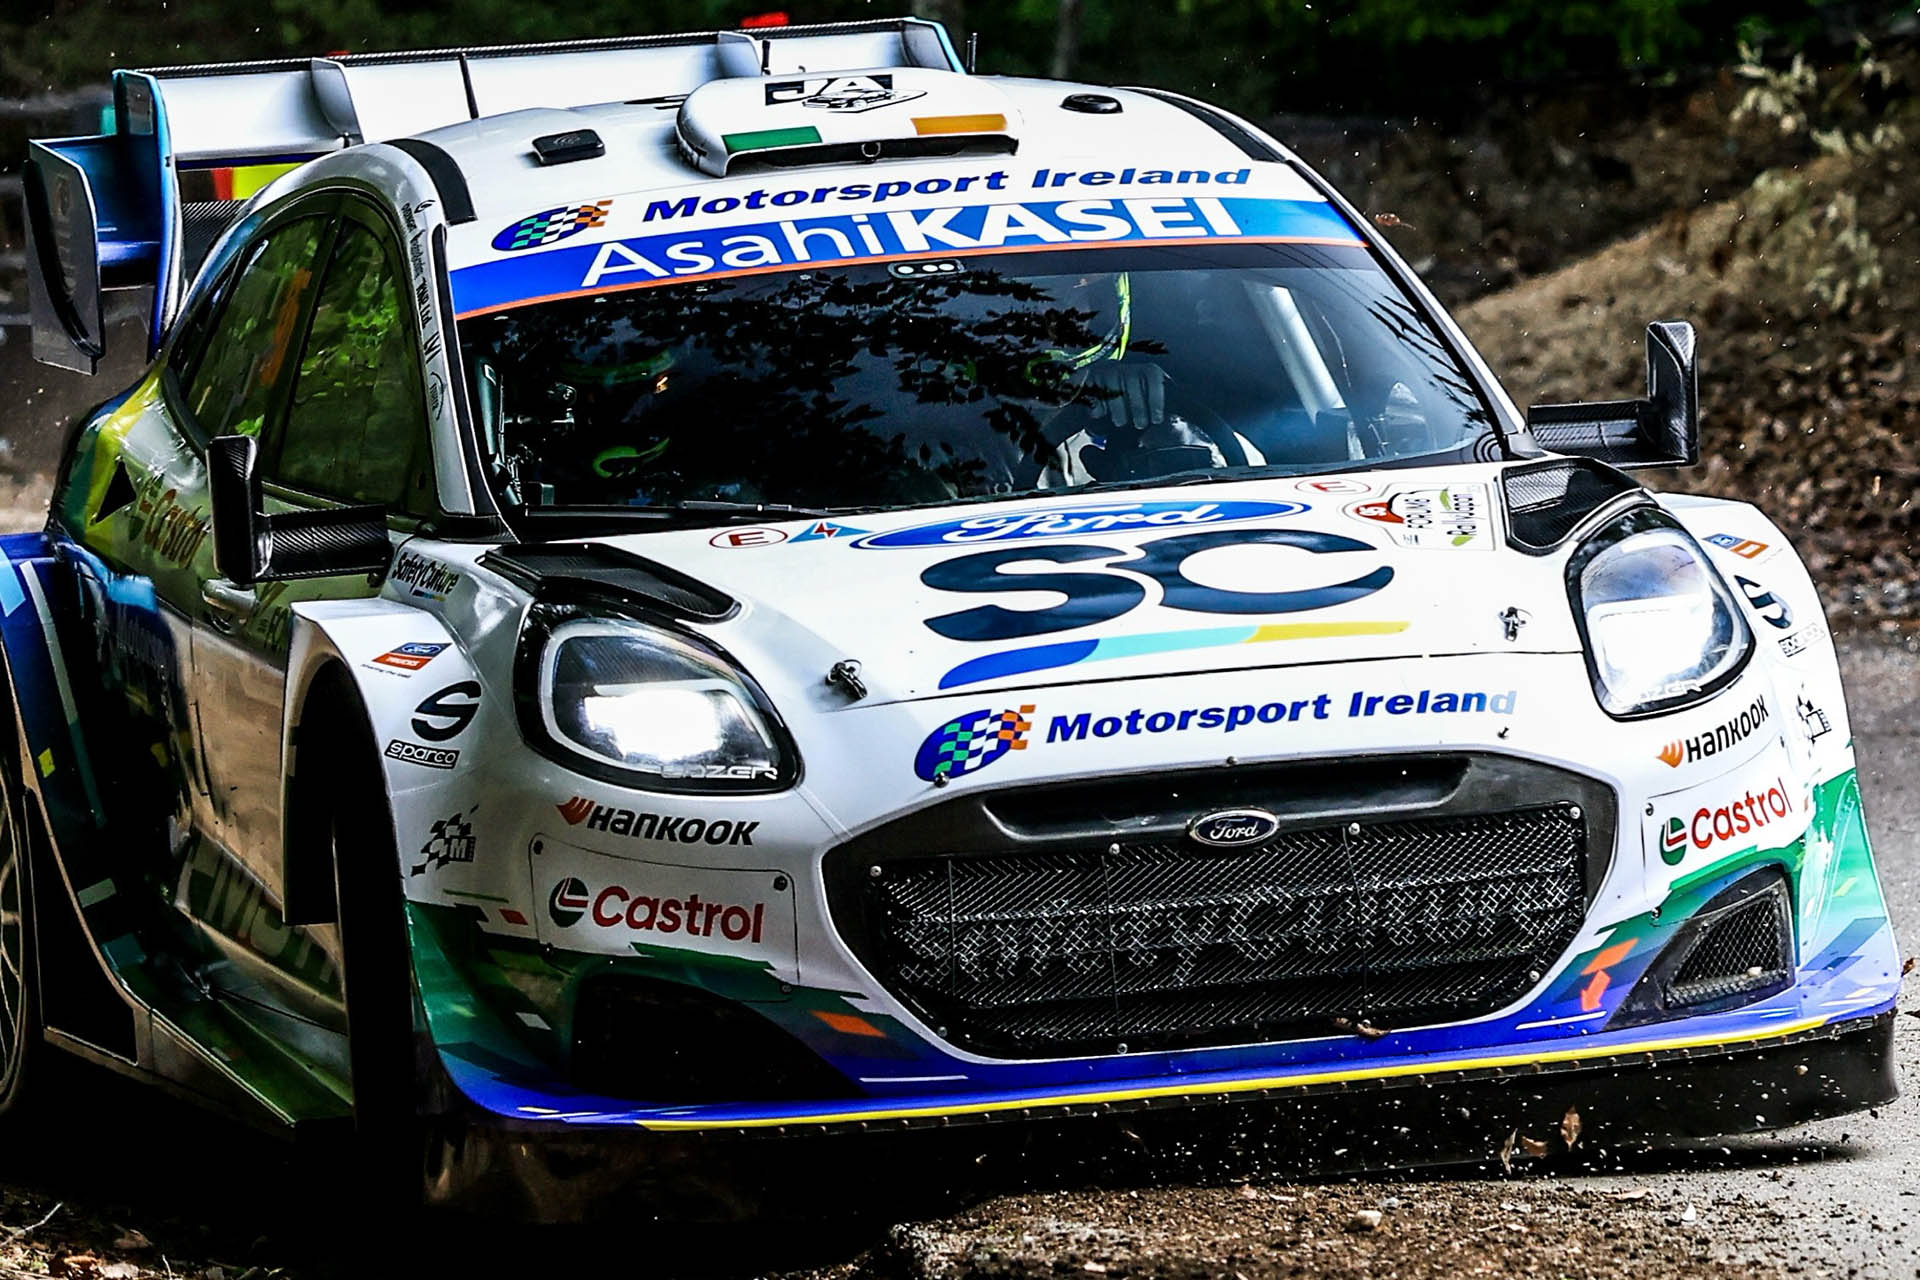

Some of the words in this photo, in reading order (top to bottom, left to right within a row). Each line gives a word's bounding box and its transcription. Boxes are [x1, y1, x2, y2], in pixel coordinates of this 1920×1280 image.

[643, 170, 1009, 222] Motorsport
[1032, 168, 1251, 188] Ireland
[942, 504, 1227, 543] Ford
[920, 528, 1394, 642] SC
[1046, 701, 1331, 744] Motorsport
[1348, 689, 1517, 718] Ireland
[389, 742, 458, 764] sparco
[1208, 817, 1262, 841] Ford
[1691, 777, 1793, 850] Castrol
[592, 885, 765, 944] Castrol
